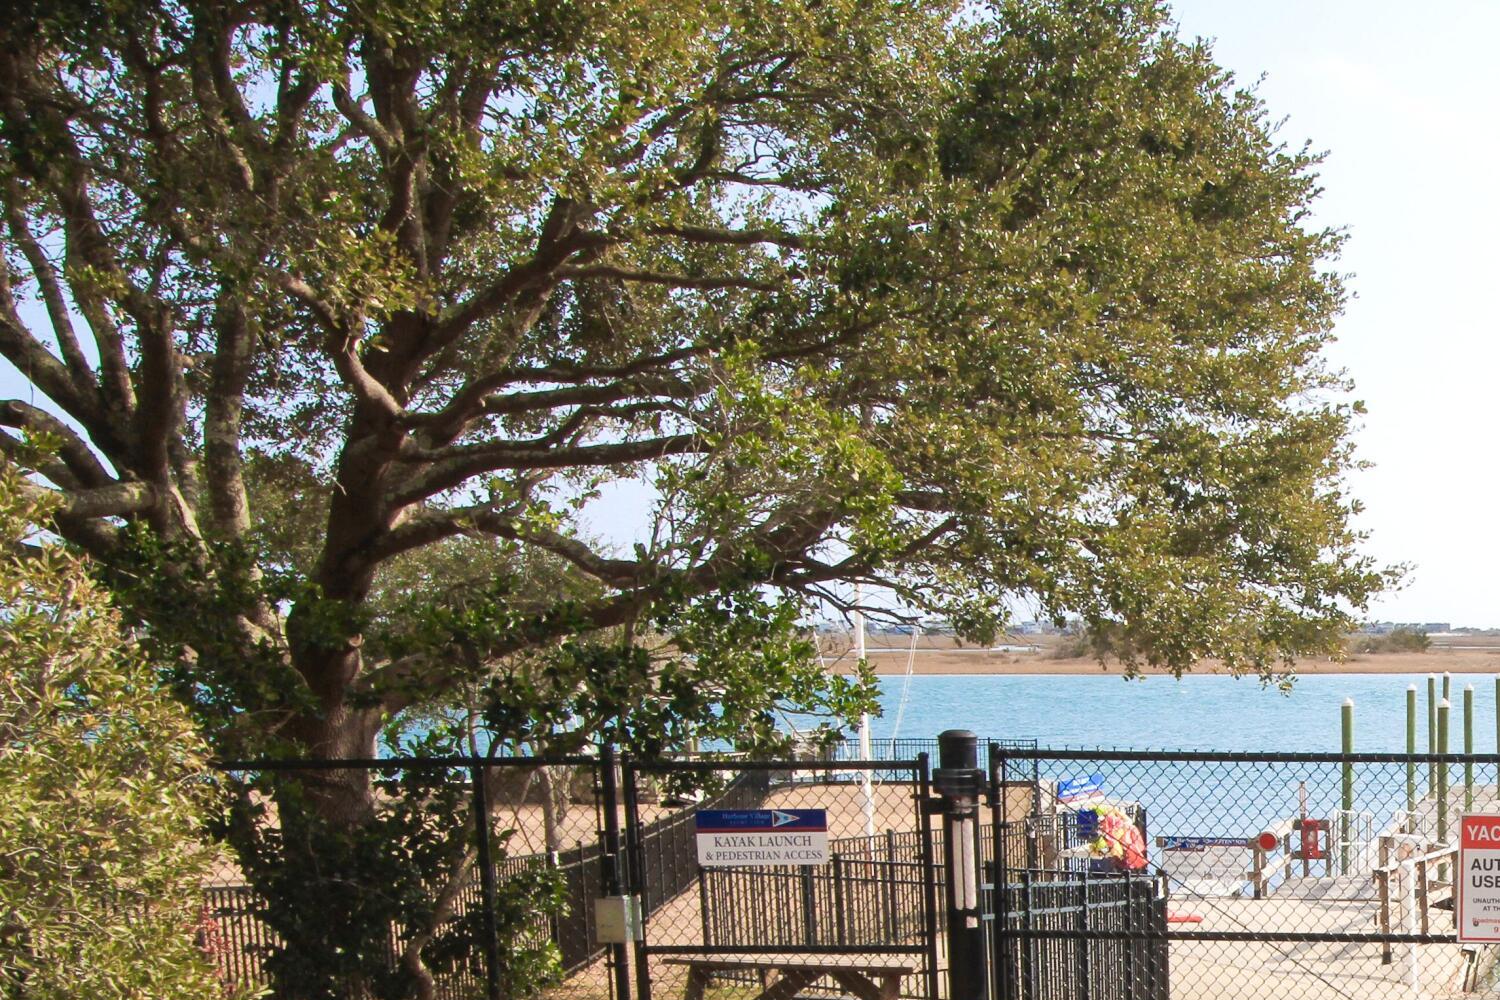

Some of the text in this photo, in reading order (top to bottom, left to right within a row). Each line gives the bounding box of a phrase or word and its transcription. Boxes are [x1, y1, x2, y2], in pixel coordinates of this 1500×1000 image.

[714, 836, 812, 848] KAYAK LAUNCH
[705, 850, 823, 861] & PEDESTRIAN ACCESS
